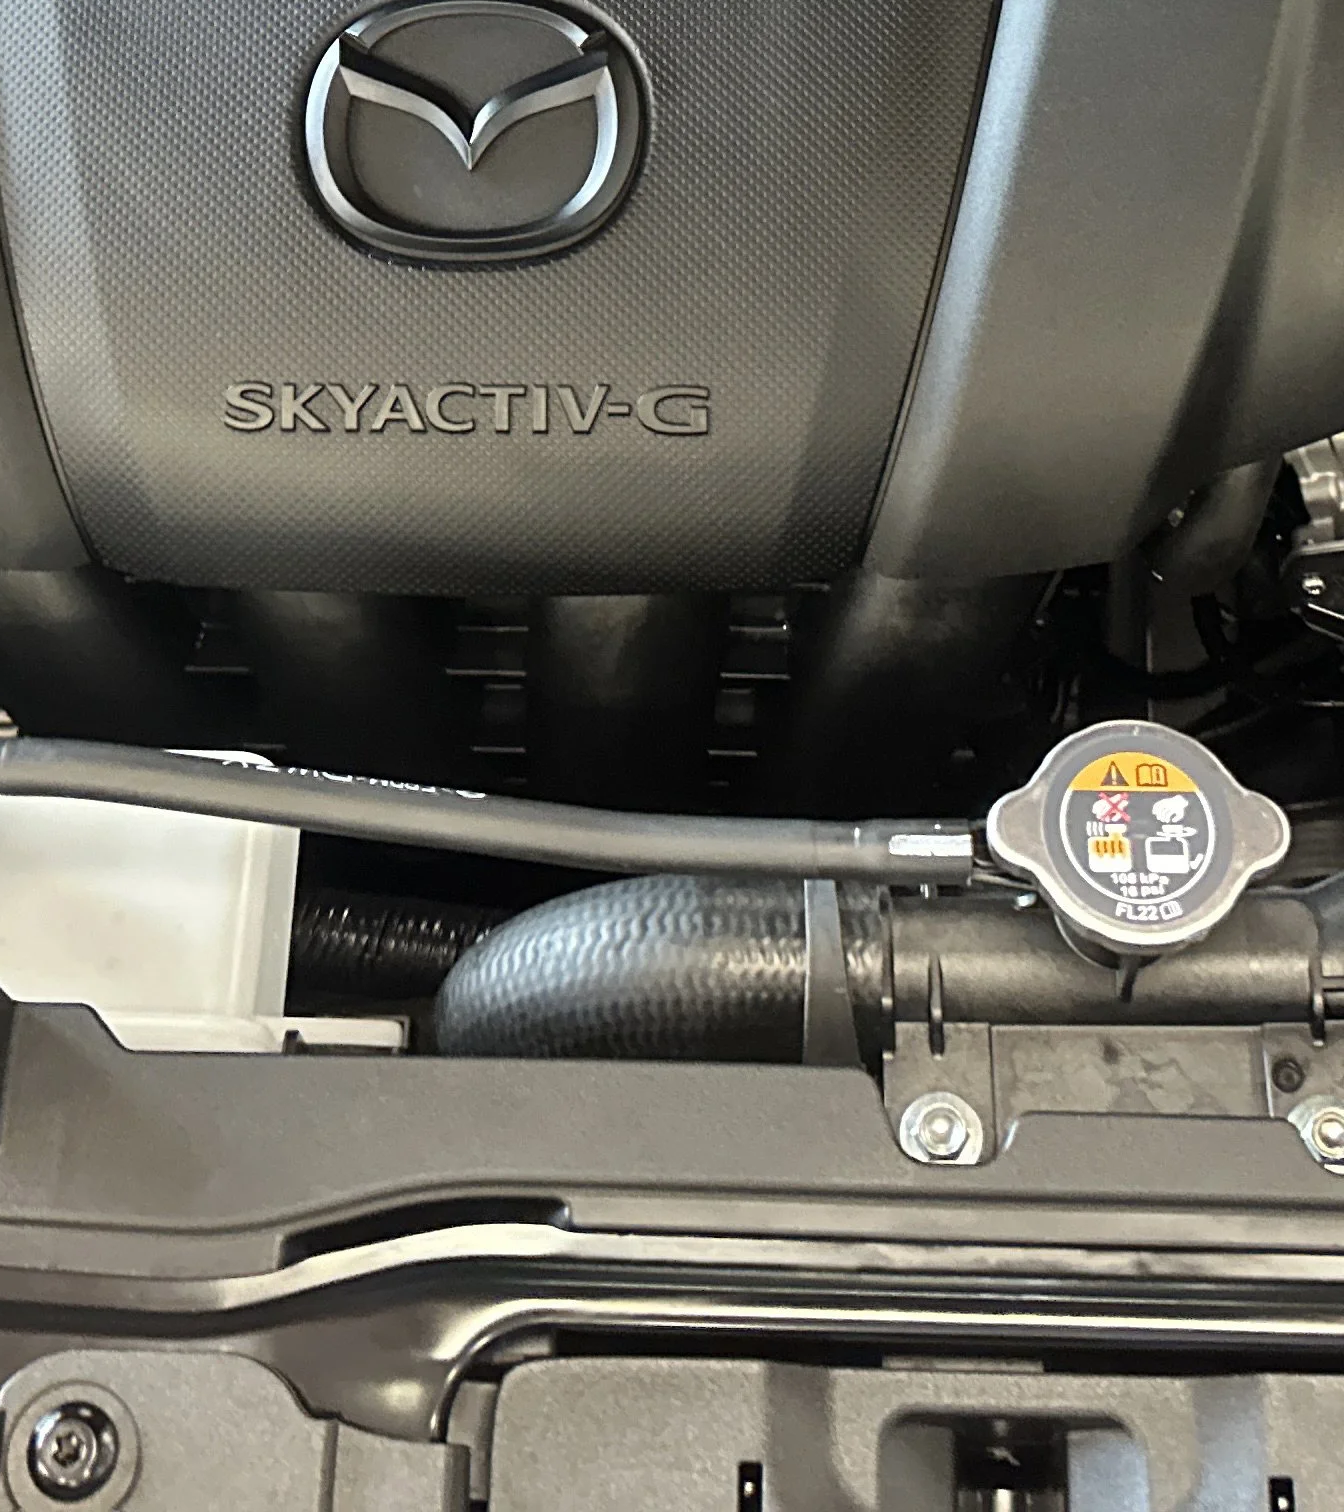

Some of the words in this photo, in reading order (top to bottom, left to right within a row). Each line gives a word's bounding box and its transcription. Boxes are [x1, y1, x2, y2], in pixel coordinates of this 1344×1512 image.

[222, 379, 713, 437] SKYACTIV-G
[1120, 885, 1139, 898] 16
[1115, 901, 1159, 921] FL22
